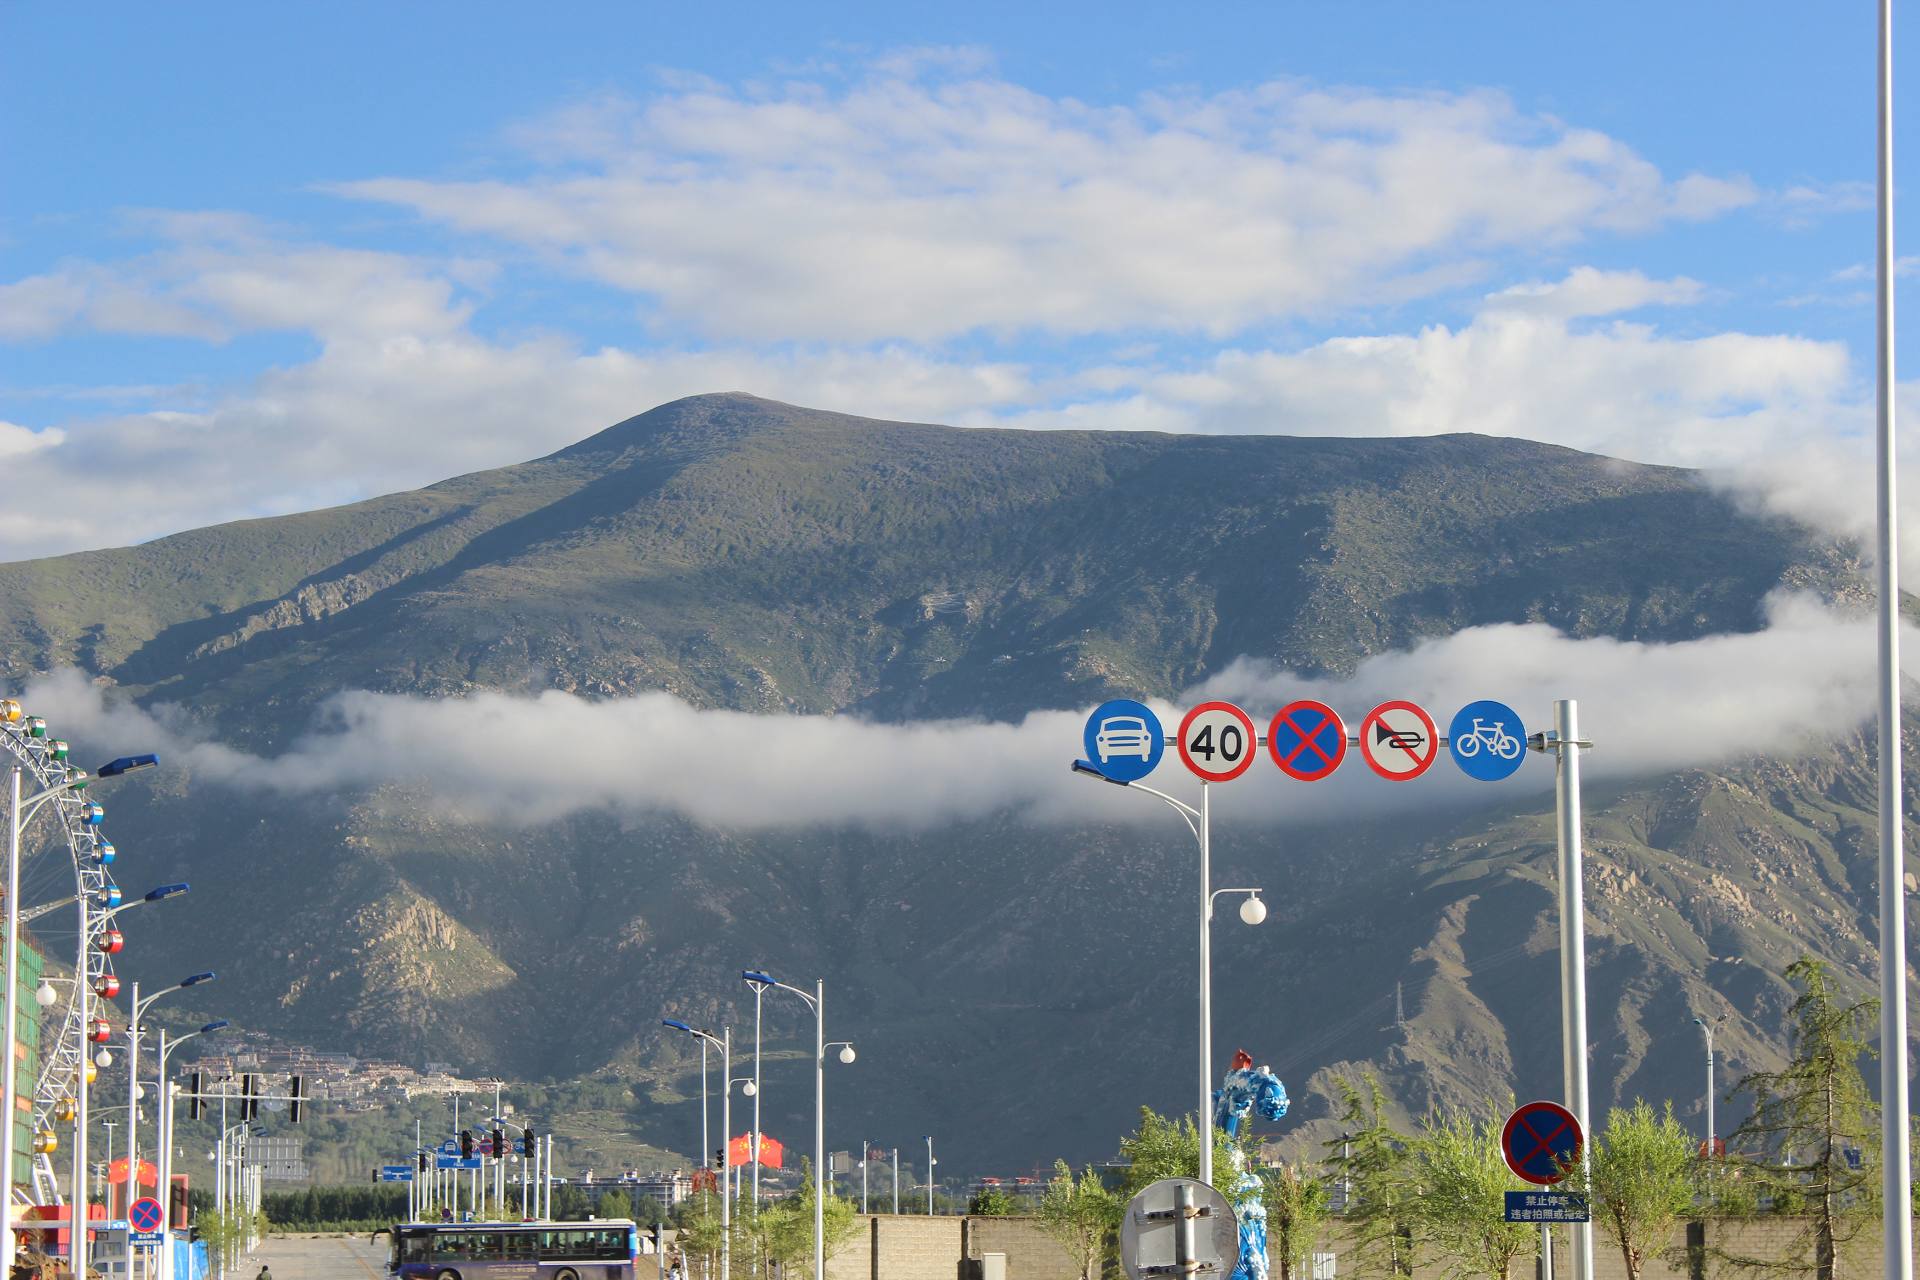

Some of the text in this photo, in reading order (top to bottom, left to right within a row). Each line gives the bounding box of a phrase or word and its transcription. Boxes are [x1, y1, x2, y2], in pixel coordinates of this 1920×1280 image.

[1190, 724, 1242, 762] 40
[1525, 1195, 1569, 1207] 禁止停车
